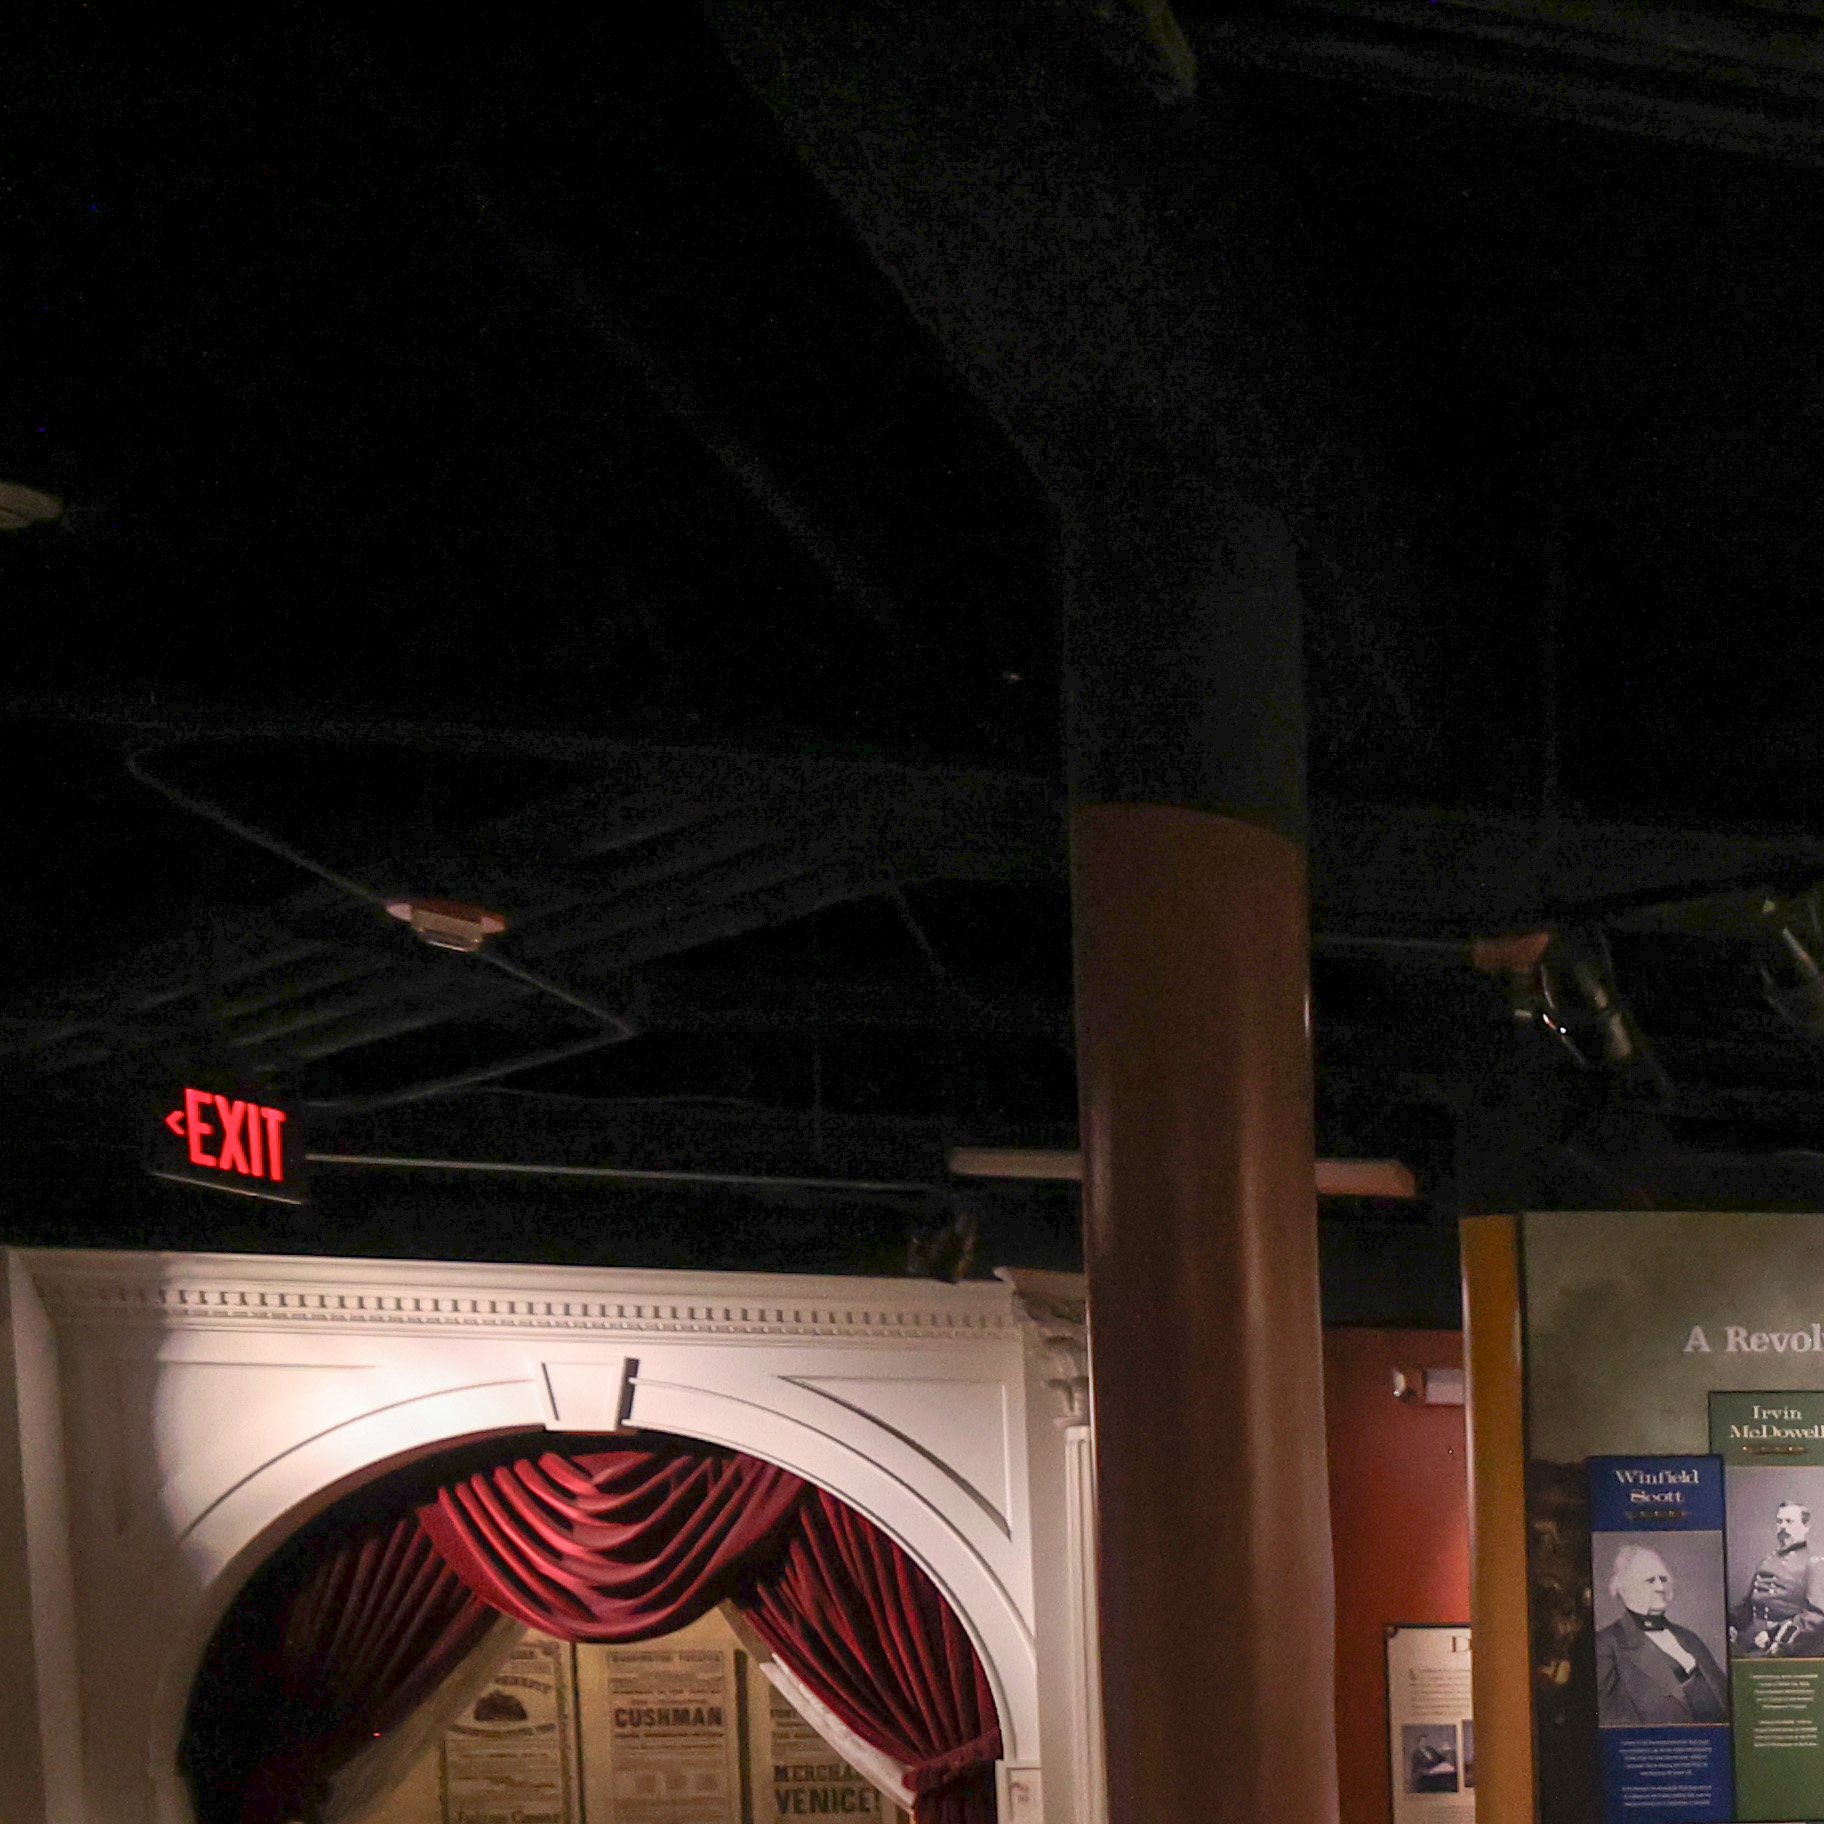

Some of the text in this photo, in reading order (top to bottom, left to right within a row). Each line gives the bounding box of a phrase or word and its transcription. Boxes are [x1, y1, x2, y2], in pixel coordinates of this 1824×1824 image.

[184, 1087, 288, 1183] EXIT
[1683, 1326, 1711, 1352] A
[1752, 1406, 1801, 1419] Irvin
[1615, 1470, 1698, 1484] Winfield
[1630, 1490, 1683, 1502] Scott
[614, 1706, 722, 1730] CUSHMAN
